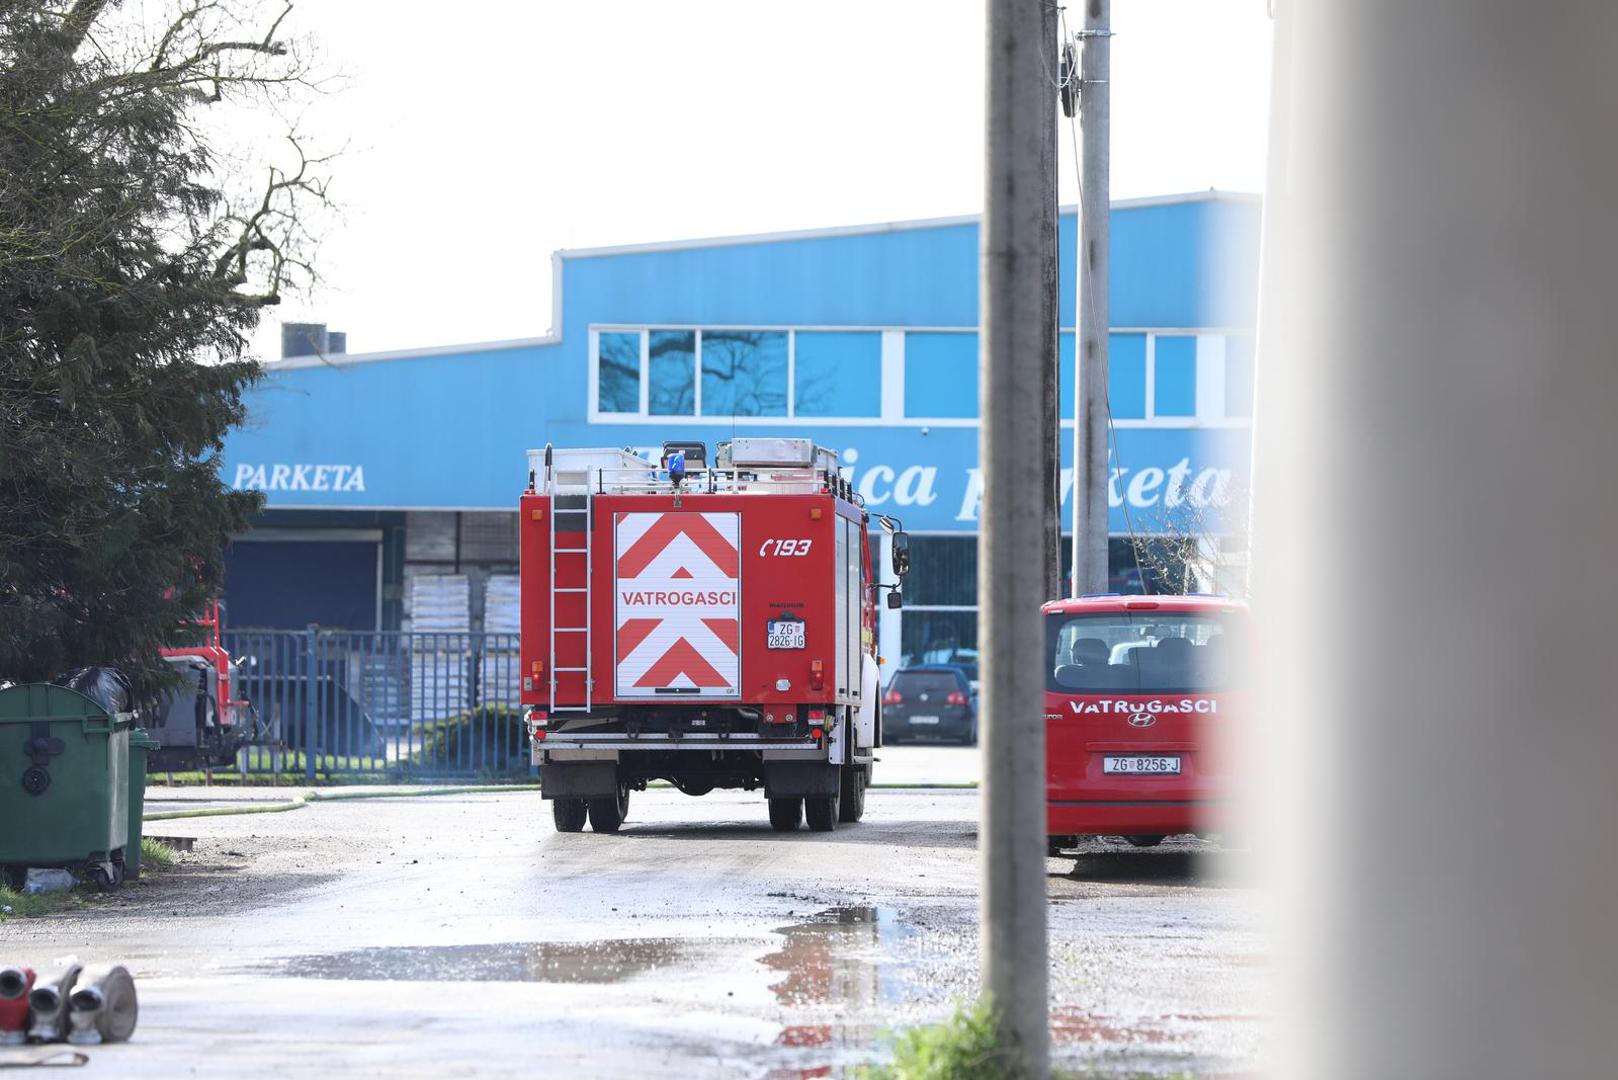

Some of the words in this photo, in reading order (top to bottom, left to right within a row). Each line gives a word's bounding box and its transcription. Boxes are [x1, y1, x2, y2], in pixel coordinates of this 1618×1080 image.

[233, 463, 366, 492] PARKETA
[773, 539, 813, 556] 193
[622, 591, 736, 605] VATROGASCI
[779, 623, 793, 635] ZG
[769, 635, 804, 646] 2826-IG
[1112, 758, 1128, 771] ZG
